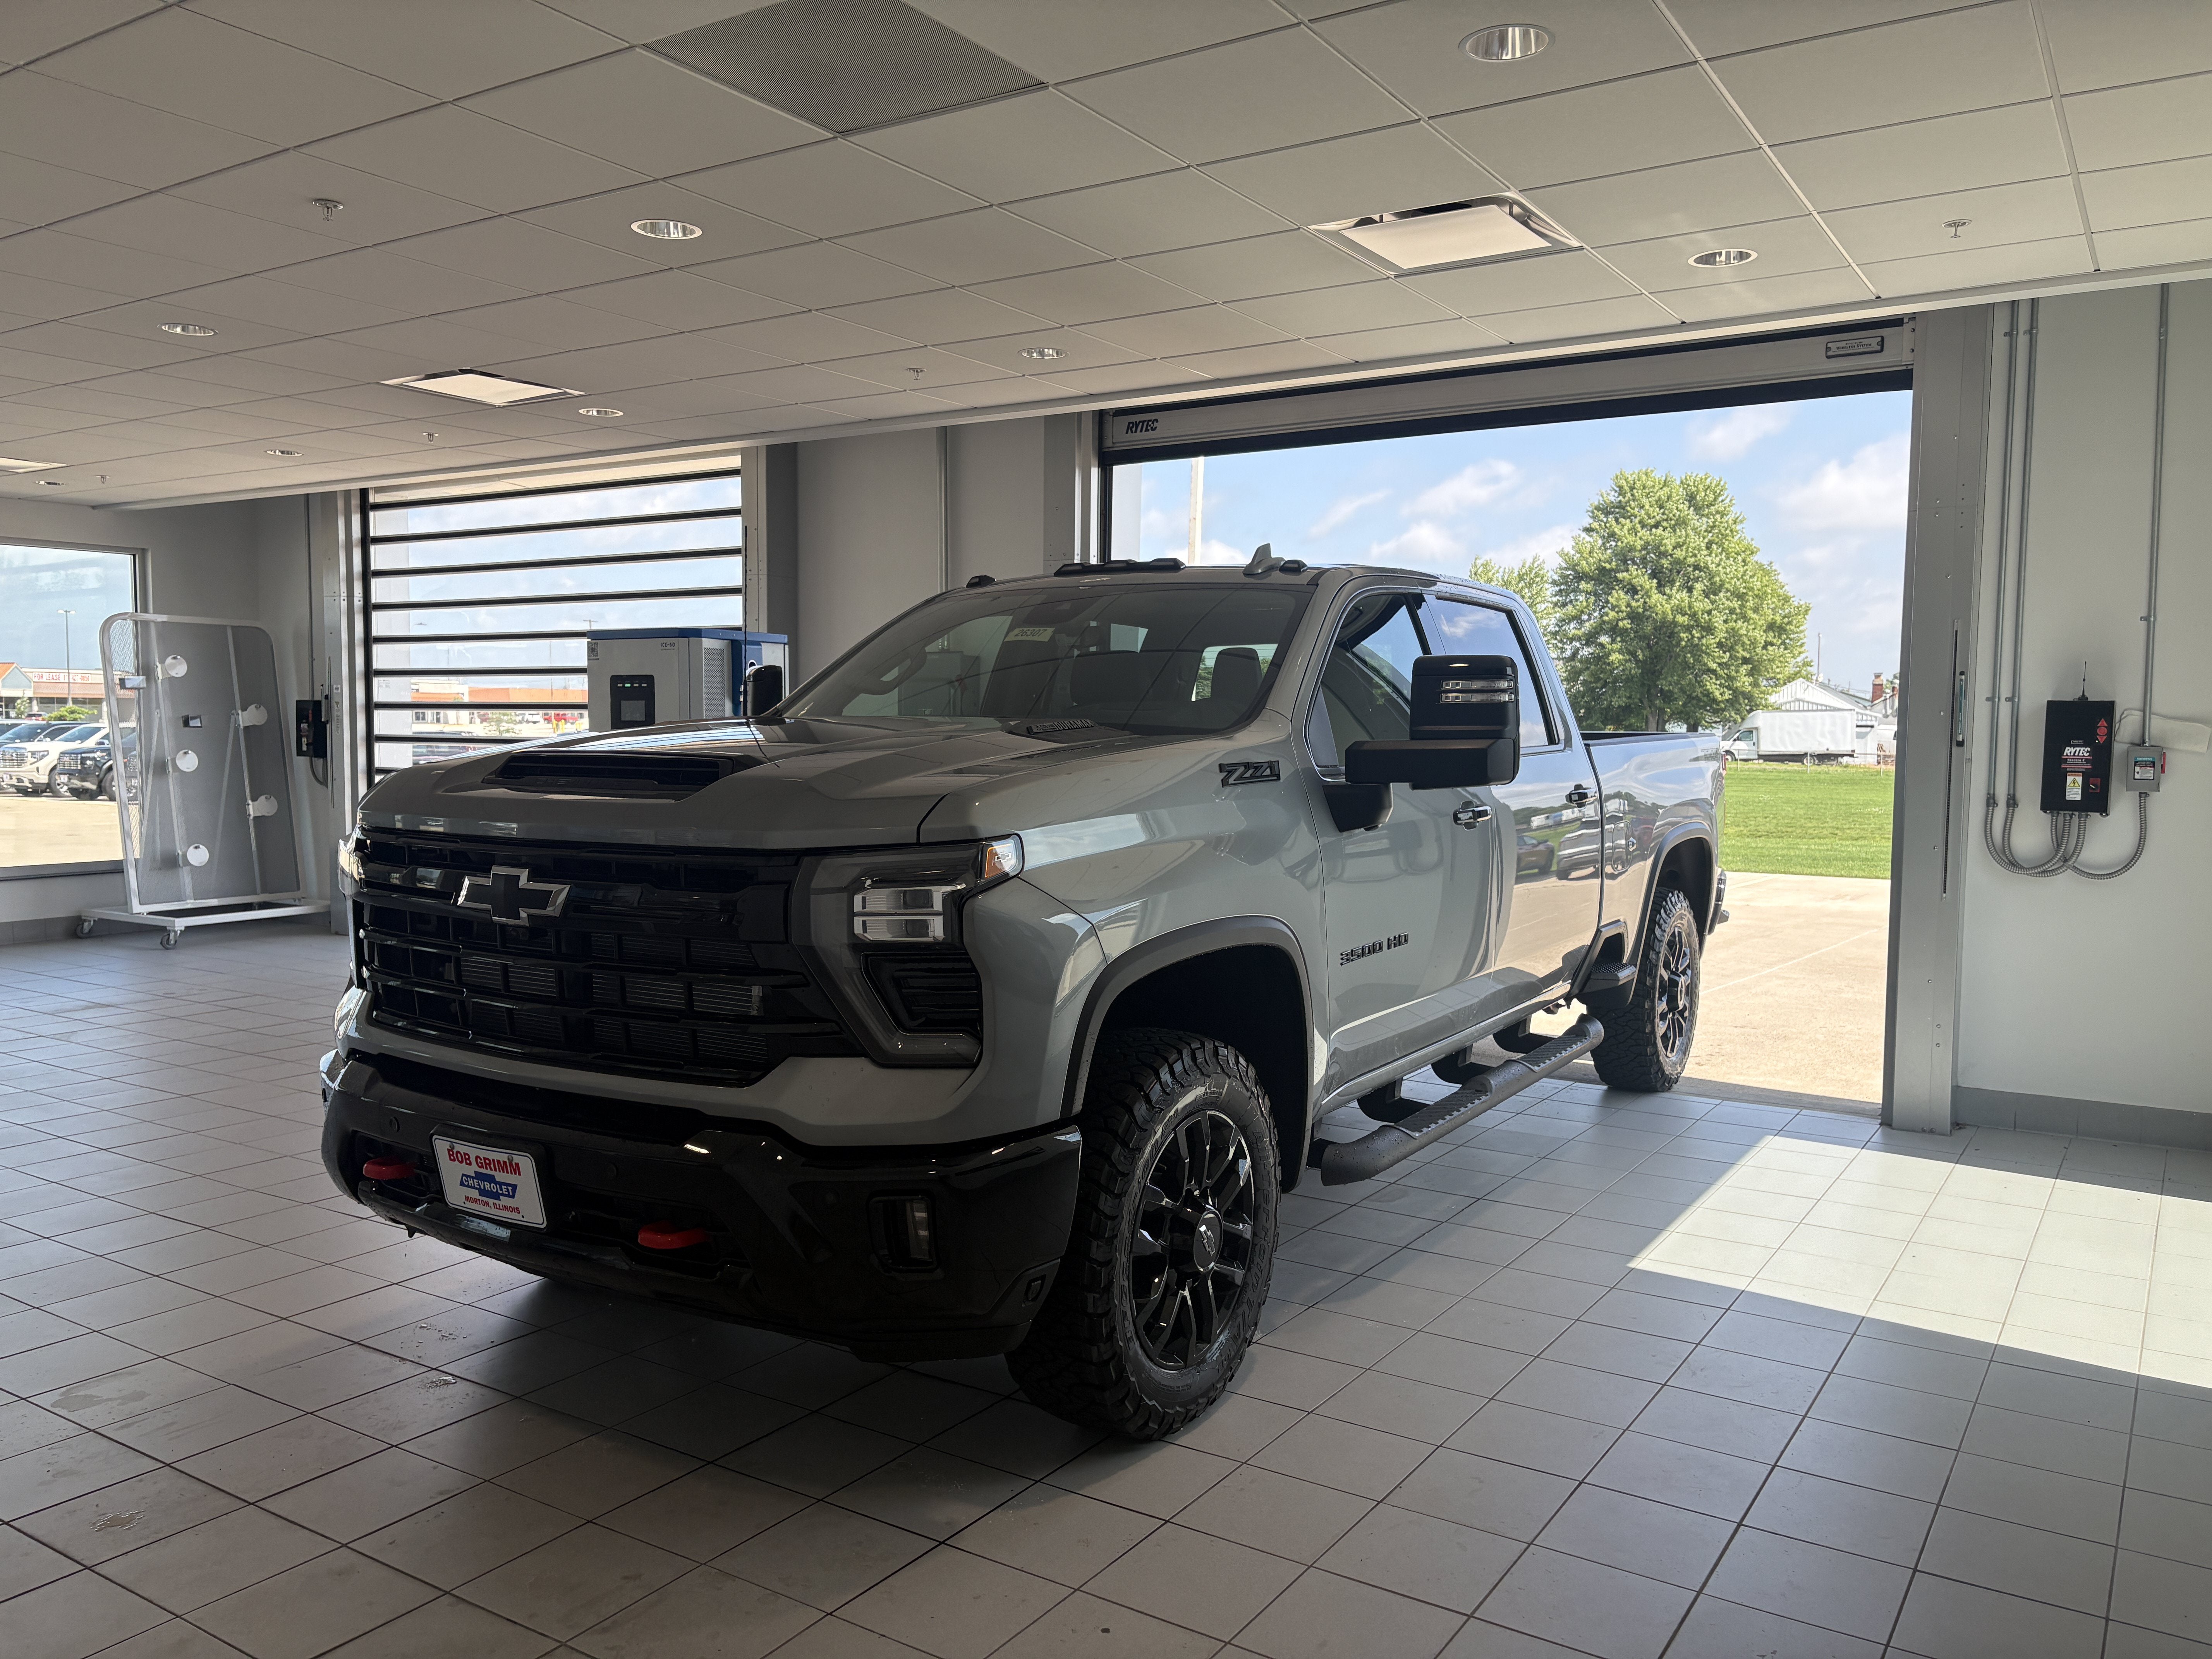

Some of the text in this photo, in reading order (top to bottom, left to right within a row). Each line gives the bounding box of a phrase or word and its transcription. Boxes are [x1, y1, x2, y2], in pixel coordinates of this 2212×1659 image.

[1125, 419, 1159, 434] RYTEC
[1055, 719, 1094, 730] DURAMAX
[2063, 747, 2090, 756] RYTEC
[1219, 760, 1281, 788] Z71
[1340, 932, 1409, 966] 3500 HD
[447, 1148, 521, 1176] BOB GRIMM
[462, 1176, 512, 1195] CHEVROLET
[465, 1195, 520, 1214] MORTON, ILLINOIS
